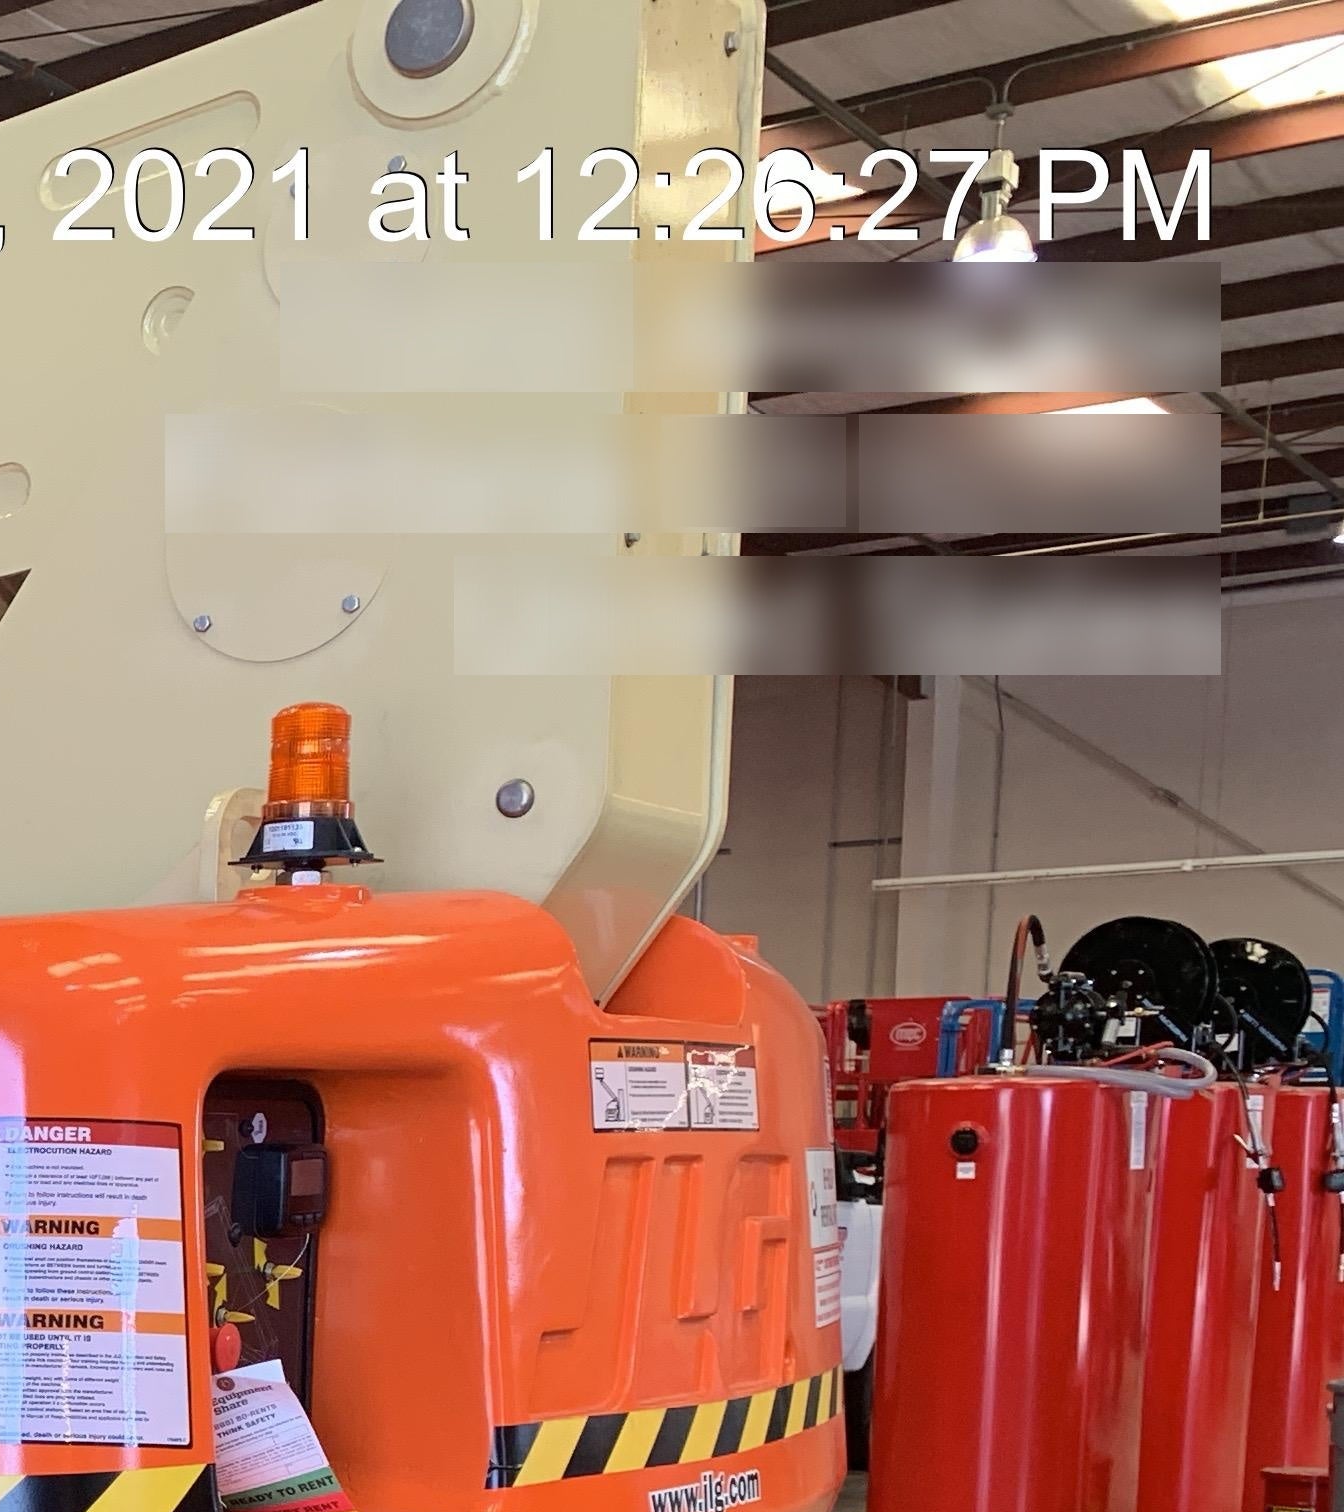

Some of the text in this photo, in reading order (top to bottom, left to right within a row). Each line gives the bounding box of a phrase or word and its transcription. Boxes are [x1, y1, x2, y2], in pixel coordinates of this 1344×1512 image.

[4, 1126, 92, 1143] DANGER
[6, 1146, 113, 1156] ELCTROCUTION HAZARD
[2, 1218, 100, 1235] WARNING
[76, 1288, 115, 1296] instruction
[23, 1333, 46, 1341] USED
[212, 1384, 274, 1407] Equipment
[214, 1398, 249, 1416] Share
[216, 1412, 277, 1439] THINK SAFETY
[229, 1475, 335, 1507] READY TO RENT
